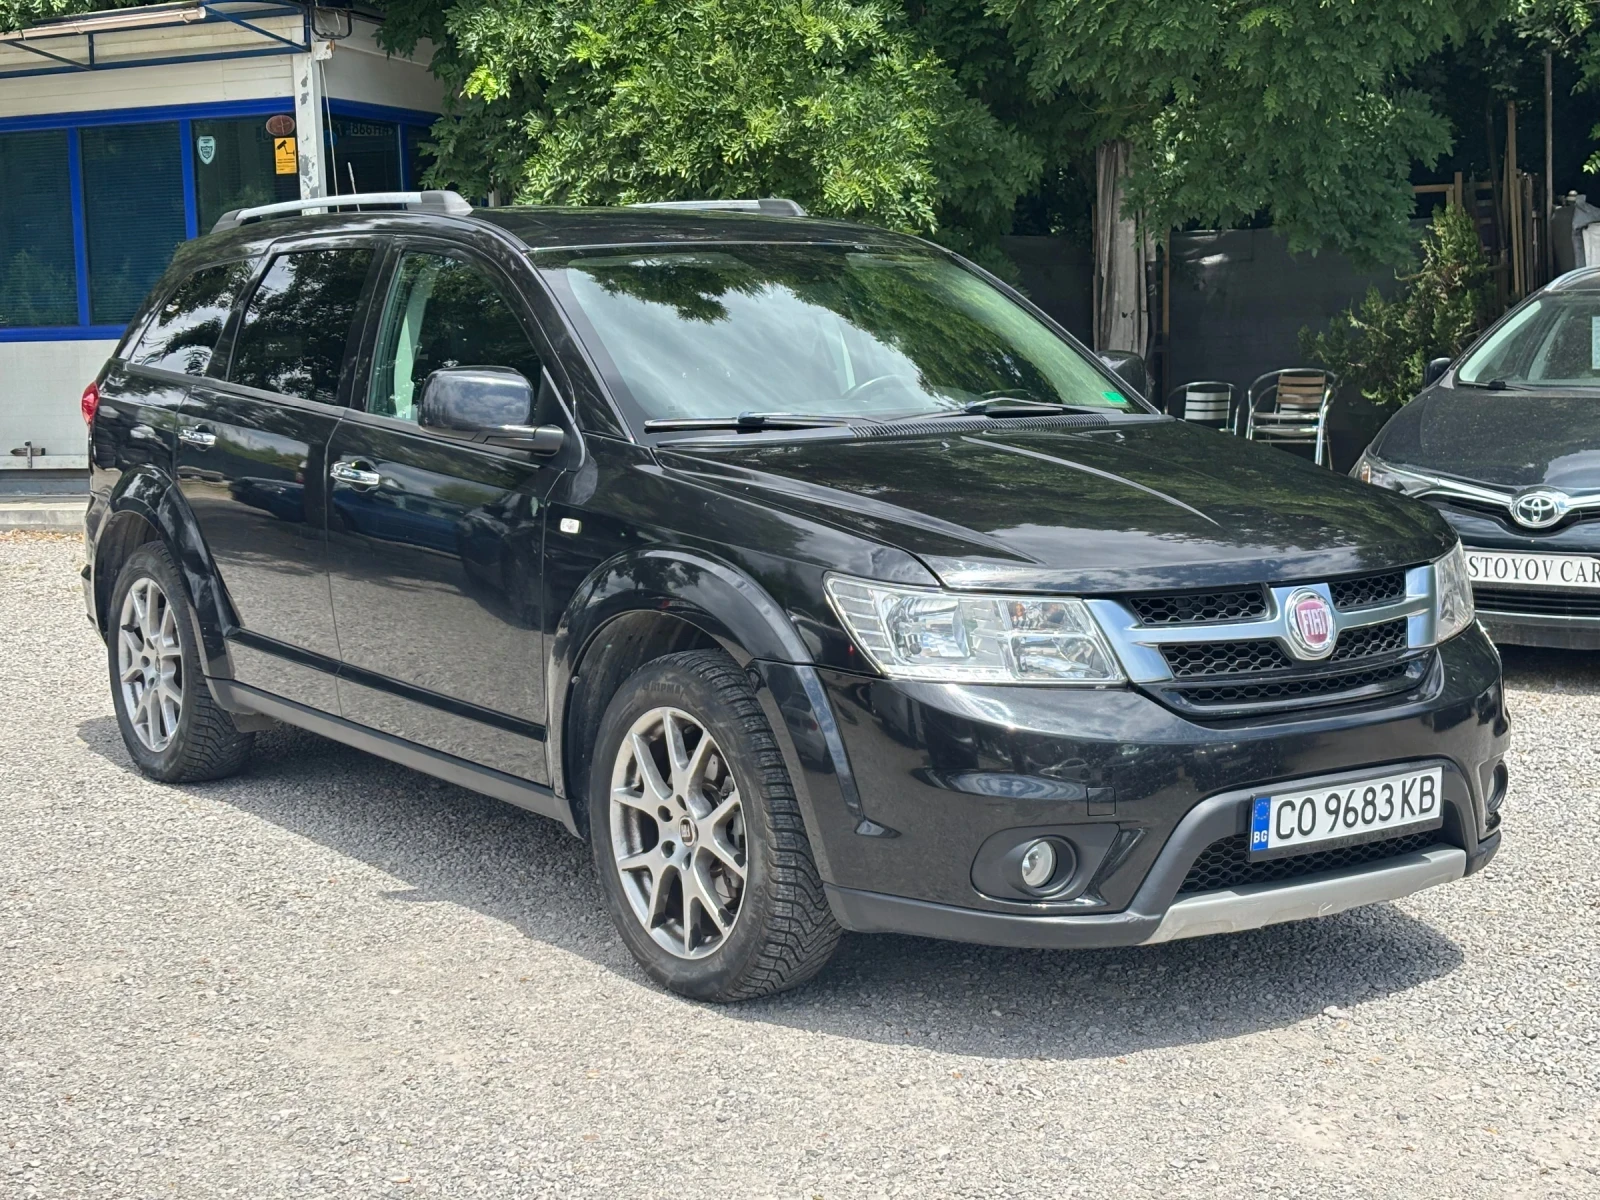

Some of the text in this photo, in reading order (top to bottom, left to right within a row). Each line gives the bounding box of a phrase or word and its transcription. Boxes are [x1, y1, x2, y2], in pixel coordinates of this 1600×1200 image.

[1468, 555, 1554, 581] STOYOV
[1300, 607, 1327, 637] FIAT
[1324, 782, 1395, 833] 9683
[1400, 774, 1436, 819] KB
[1253, 830, 1268, 843] BG
